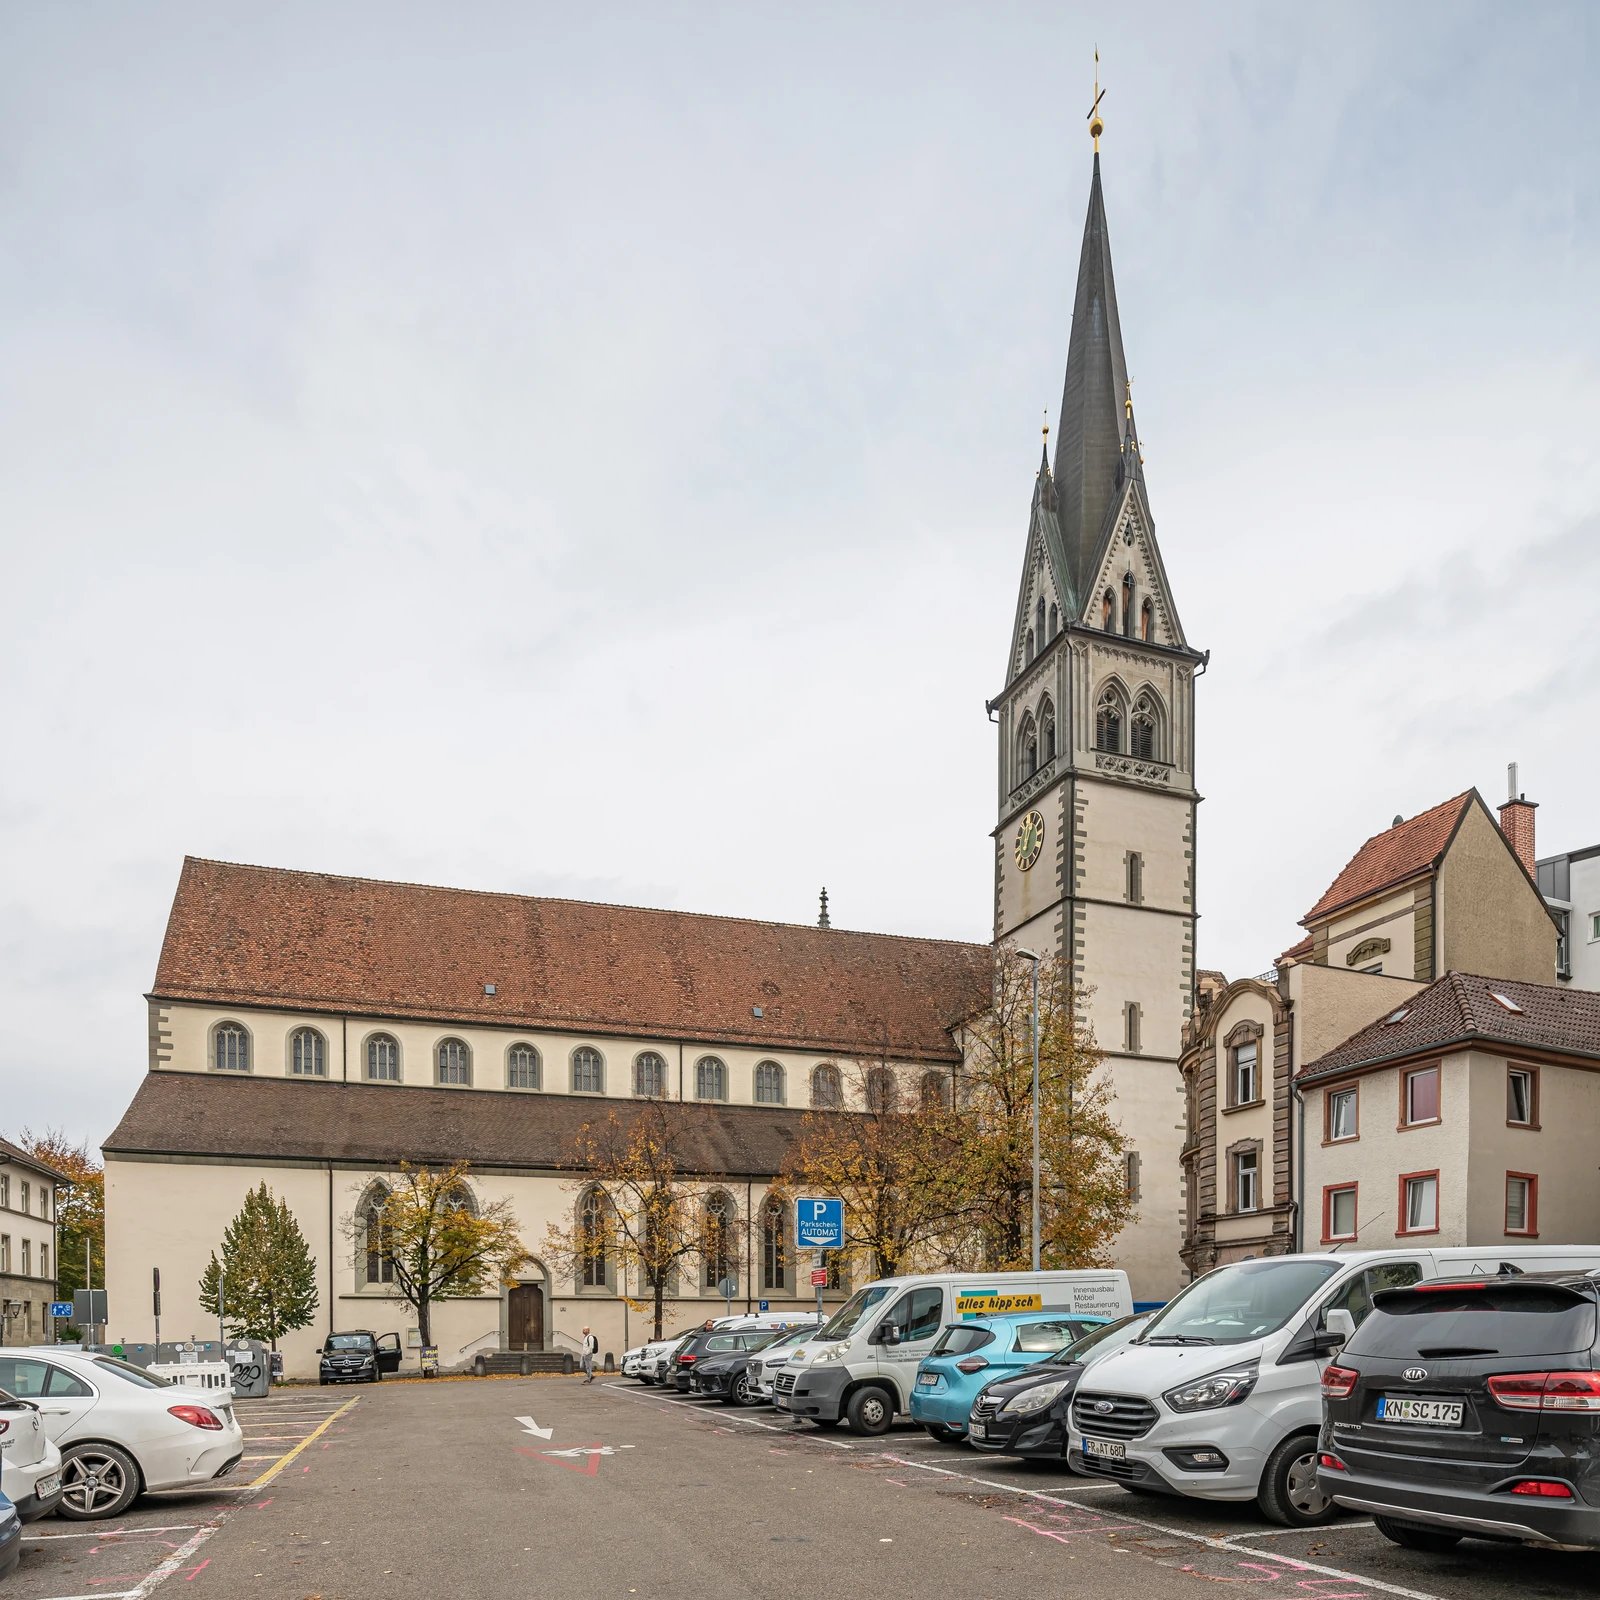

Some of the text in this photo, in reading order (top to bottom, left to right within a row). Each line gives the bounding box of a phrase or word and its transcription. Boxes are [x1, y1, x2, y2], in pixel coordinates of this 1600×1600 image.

[813, 1201, 827, 1221] P
[800, 1220, 839, 1228] Parkschein-
[801, 1228, 839, 1237] AUTOMAT
[760, 1301, 768, 1310] P
[958, 1298, 985, 1310] alles
[1074, 1301, 1120, 1309] Restaurierung
[1405, 1370, 1422, 1379] KIA
[1385, 1401, 1461, 1421] KN SC 175
[1087, 1440, 1124, 1457] FR AT 680
